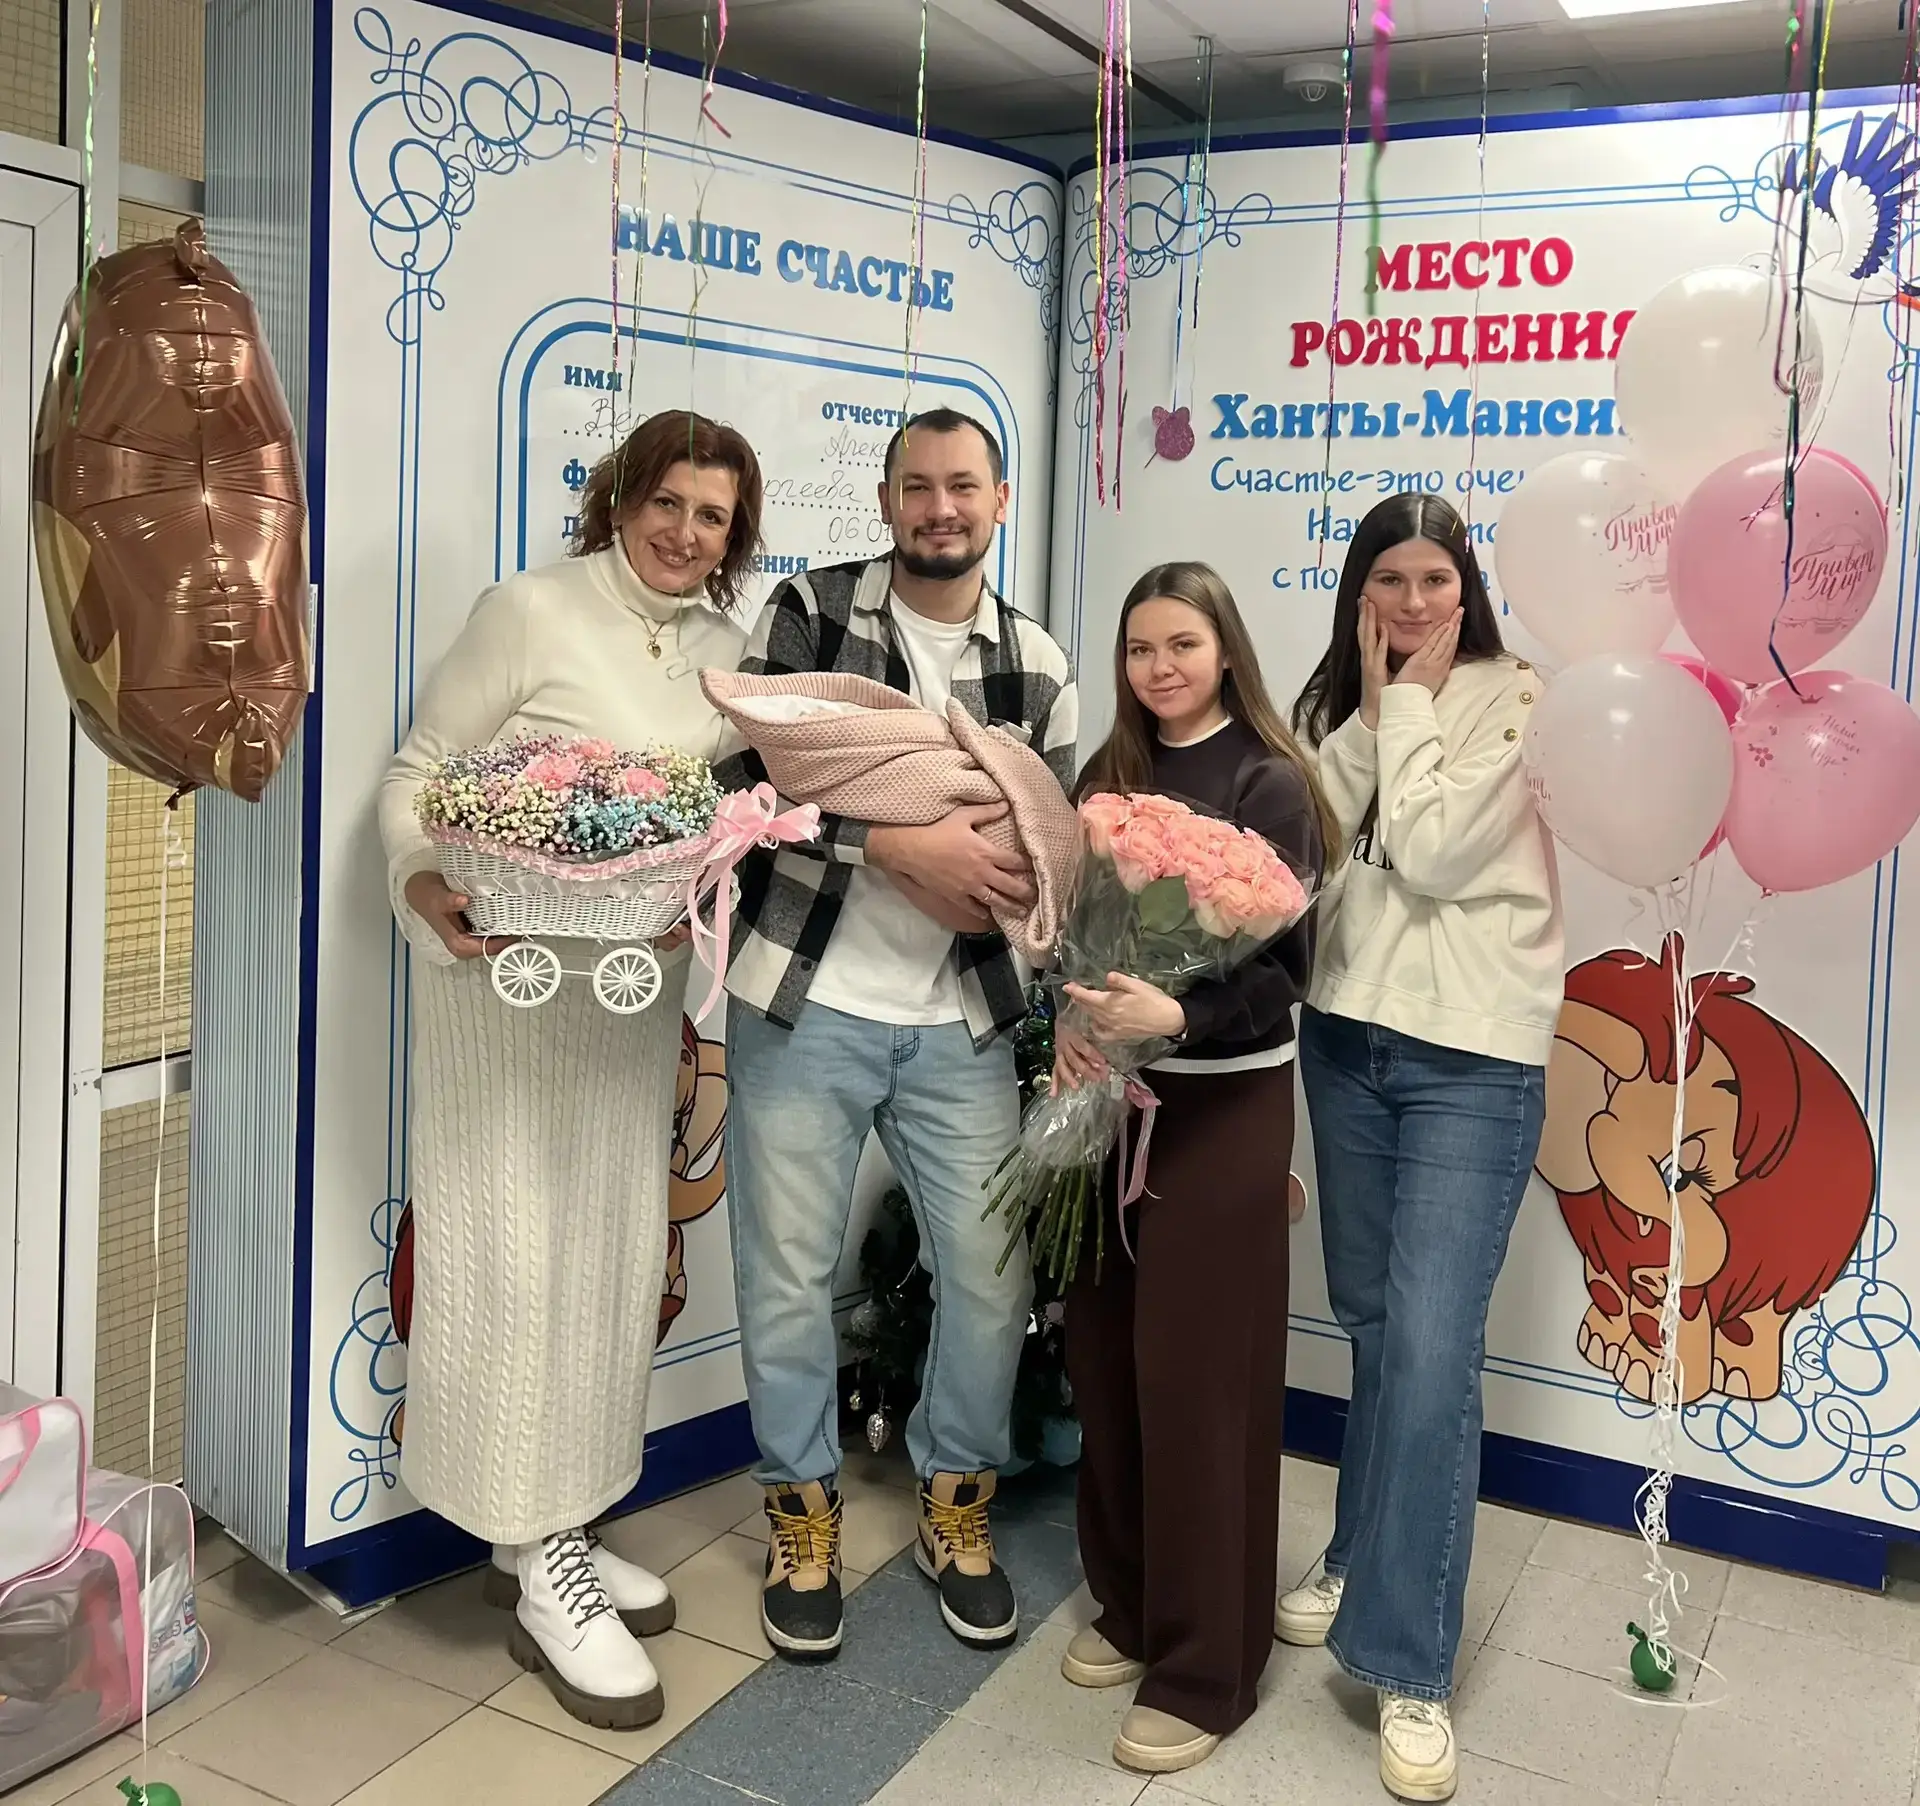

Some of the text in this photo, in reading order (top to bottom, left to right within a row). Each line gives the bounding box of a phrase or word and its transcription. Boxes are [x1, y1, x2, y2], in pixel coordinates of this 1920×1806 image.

[617, 203, 954, 312] НАШЕ СЧАСТЬЕ
[1365, 237, 1575, 293] МЕСТО
[1210, 389, 1627, 438] Ханты-Манси
[1456, 468, 1525, 495] оче
